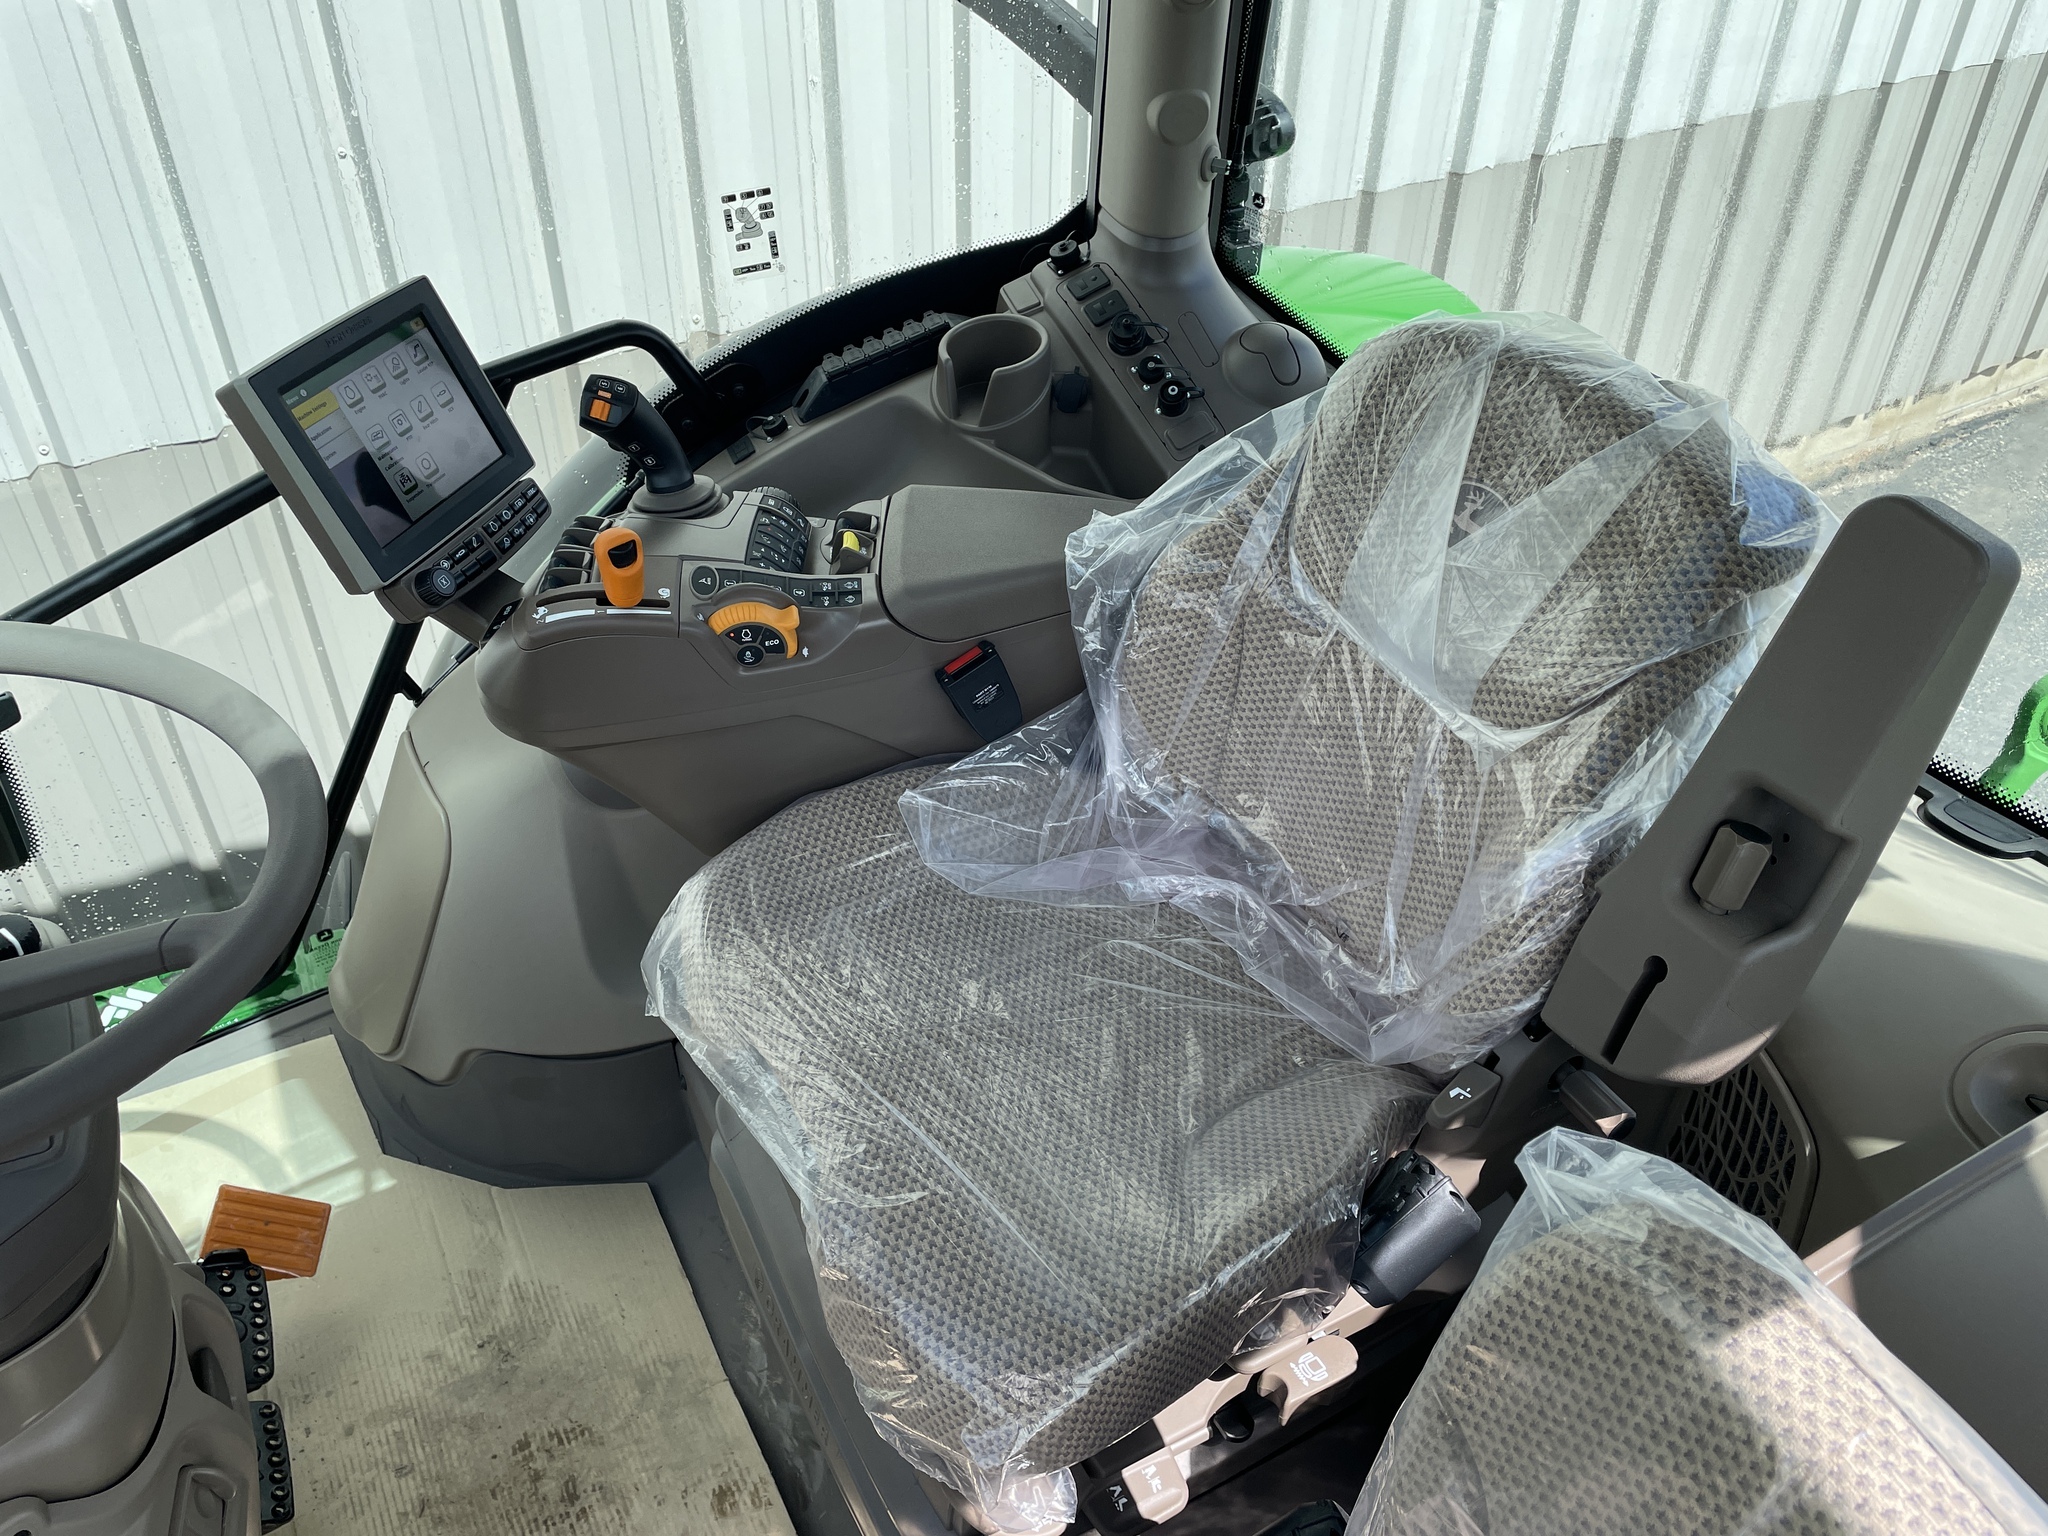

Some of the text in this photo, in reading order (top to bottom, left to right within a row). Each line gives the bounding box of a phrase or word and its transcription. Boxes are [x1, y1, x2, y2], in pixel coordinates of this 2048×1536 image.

[297, 401, 328, 421] Machine Settings
[765, 639, 780, 647] ECO
